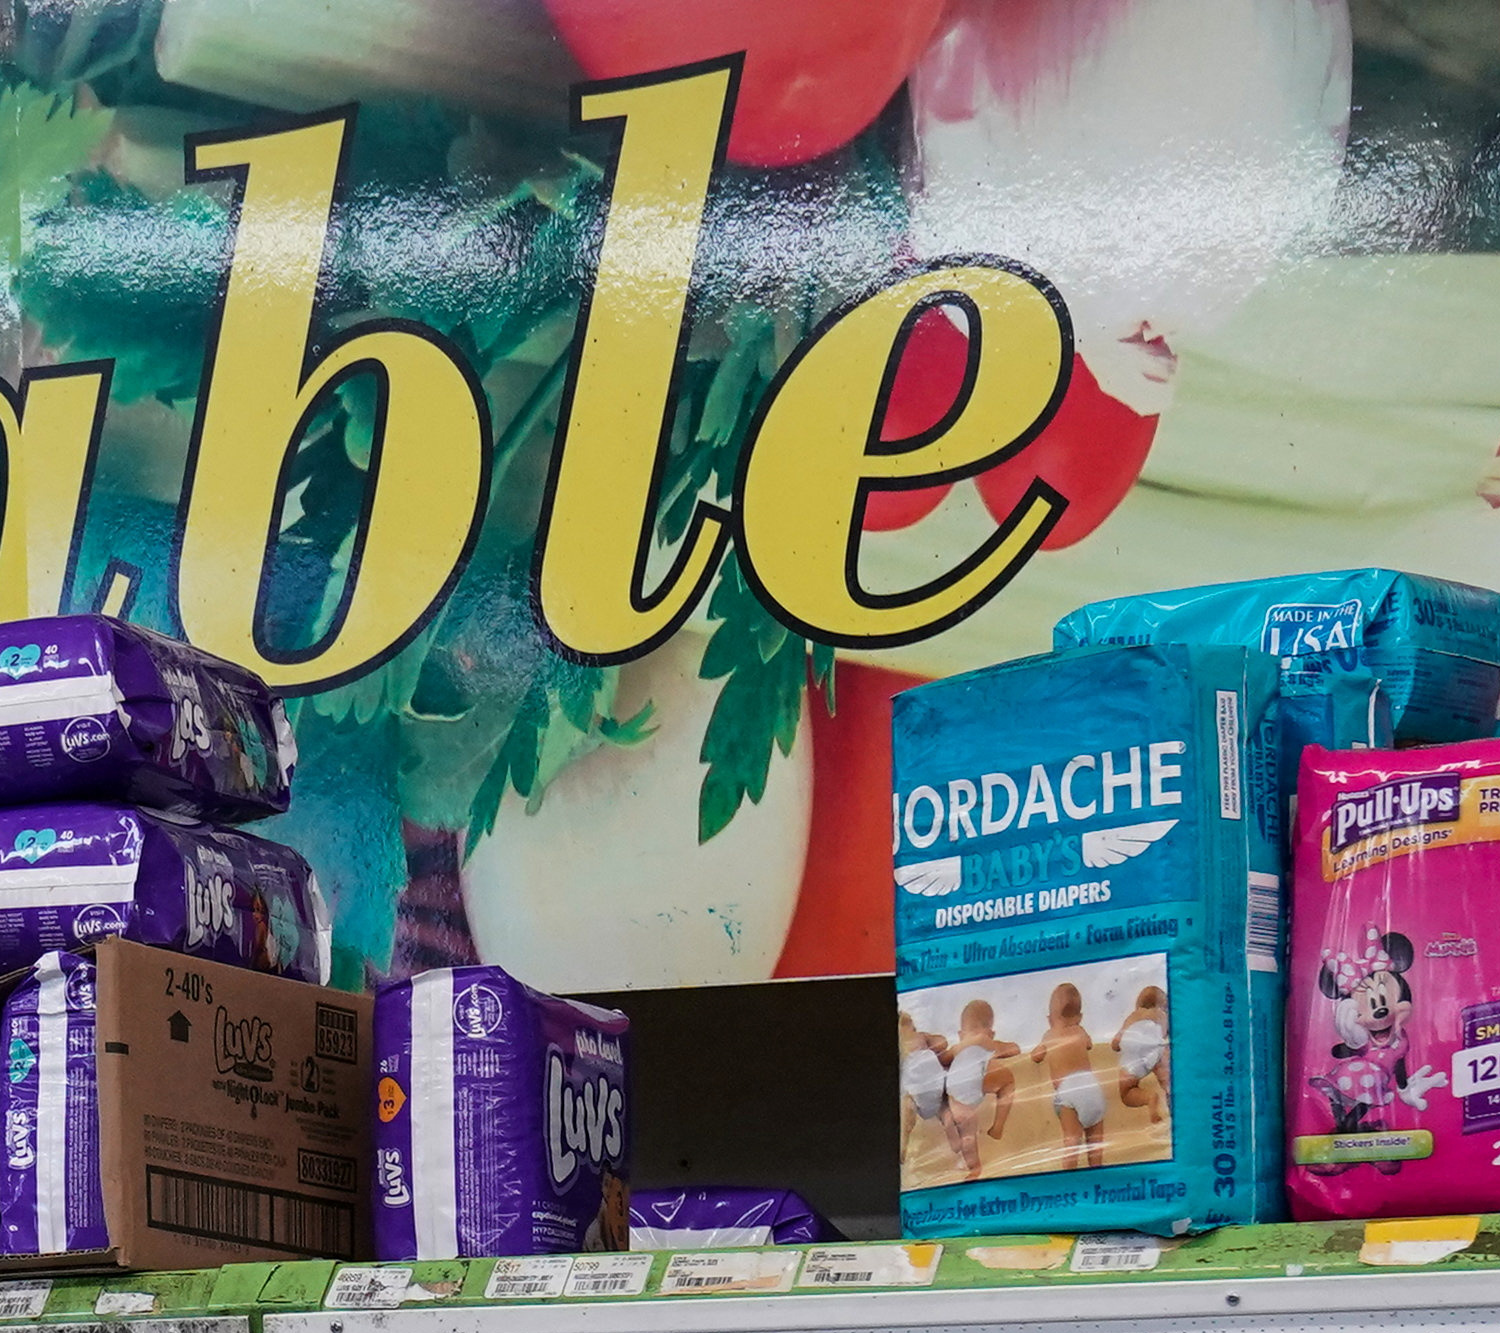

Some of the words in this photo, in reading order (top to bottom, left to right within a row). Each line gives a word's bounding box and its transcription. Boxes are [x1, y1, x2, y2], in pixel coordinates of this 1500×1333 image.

[1271, 607, 1314, 624] MADE
[1316, 605, 1333, 620] IN
[1334, 602, 1357, 618] THE
[45, 645, 58, 654] 40
[60, 730, 110, 754] Luvs.com
[893, 741, 1186, 855] JORDACHE
[1335, 782, 1458, 845] Pull-Ups
[962, 830, 1081, 895] BABY'S
[1333, 846, 1388, 873] Learning
[1391, 829, 1450, 851] Designs
[936, 891, 1034, 929] DISPOSABLE
[1038, 880, 1111, 911] DIAPERS
[963, 940, 998, 965] Ultra
[999, 931, 1071, 960] Absorbent
[1086, 923, 1125, 946] Form
[1126, 914, 1179, 939] Fitting
[165, 967, 214, 1005] 2-40's
[468, 983, 486, 1039] Luvs.com
[213, 1006, 273, 1074] Luvs
[318, 1027, 355, 1058] 85923
[379, 1059, 389, 1074] 26
[8, 1109, 33, 1167] Luvs
[547, 1055, 625, 1184] Luvs
[1211, 1091, 1224, 1150] SMALL
[1225, 1112, 1236, 1150] 8-15
[380, 1149, 410, 1206] Luvs
[956, 1203, 976, 1218] For
[978, 1198, 1017, 1217] Extra
[1018, 1190, 1079, 1215] Dryness
[1093, 1183, 1147, 1207] Frontal
[1148, 1179, 1187, 1204] Tape
[1213, 1154, 1236, 1198] 30
